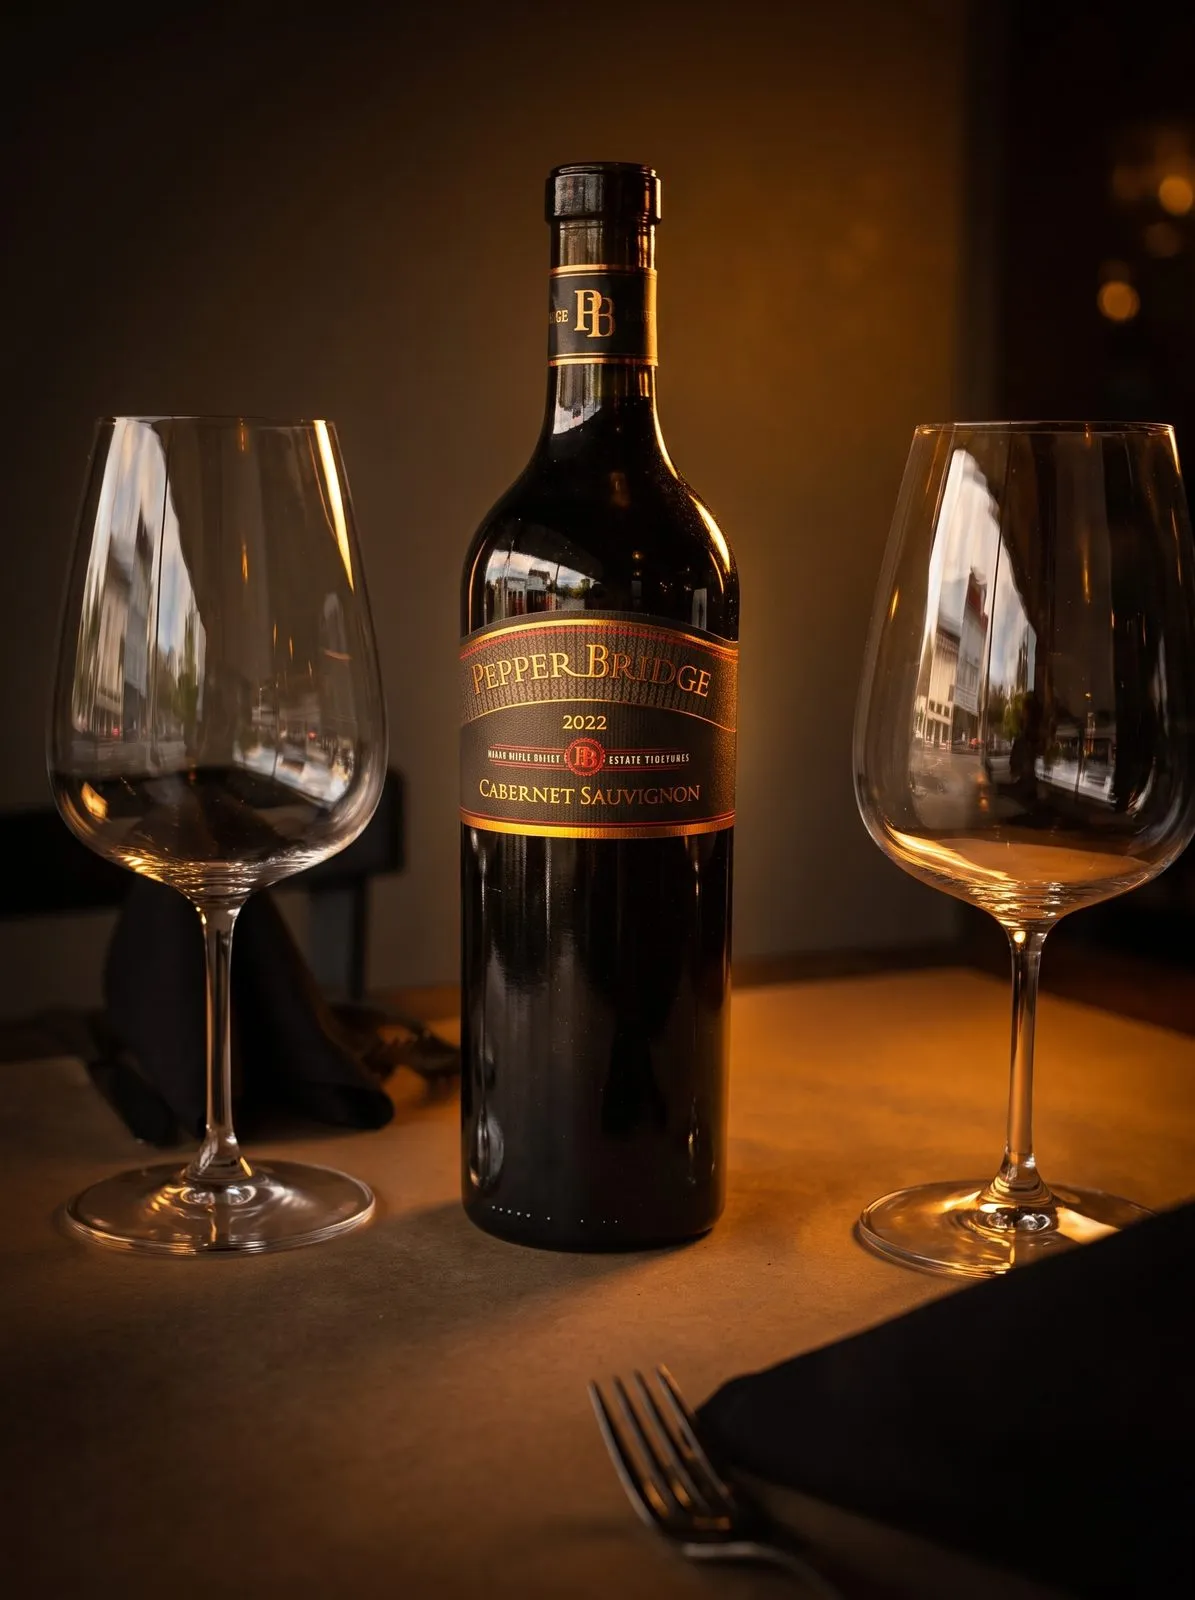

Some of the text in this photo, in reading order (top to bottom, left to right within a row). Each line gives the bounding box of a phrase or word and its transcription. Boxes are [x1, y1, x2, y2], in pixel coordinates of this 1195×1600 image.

[472, 644, 712, 698] PEPPER BRIDGE
[562, 715, 607, 730] 2022
[609, 755, 641, 765] ESTATE
[479, 779, 701, 806] CABERNET SAUVIGNON
